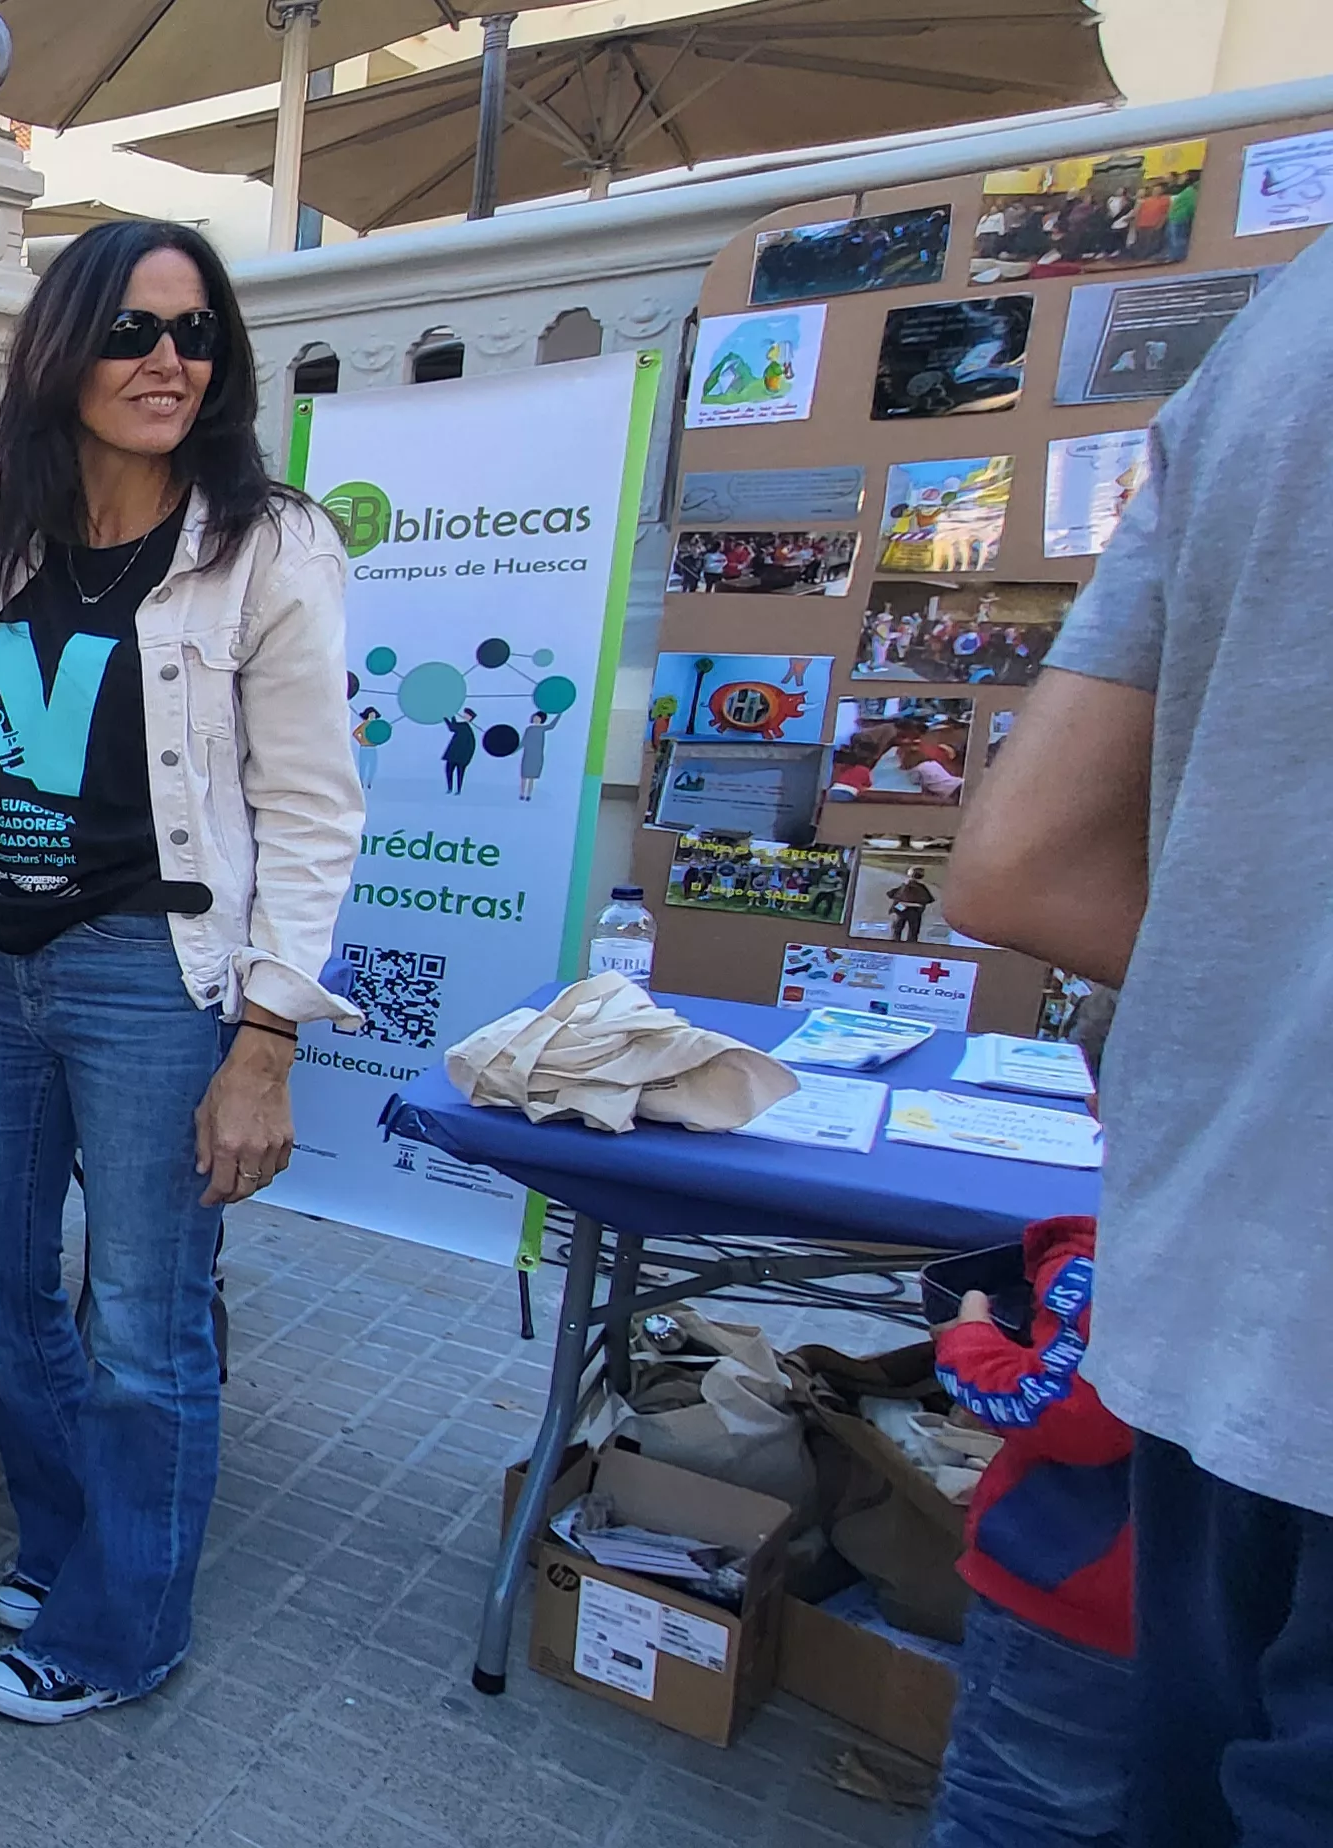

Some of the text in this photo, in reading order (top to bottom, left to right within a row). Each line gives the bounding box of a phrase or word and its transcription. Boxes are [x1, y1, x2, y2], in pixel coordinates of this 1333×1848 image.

[348, 497, 591, 547] Bibliotecas
[353, 558, 588, 582] Campus de Huesca
[44, 854, 75, 867] Night
[353, 883, 525, 922] nosotras!
[898, 985, 966, 1000] Cruz Roja
[549, 1564, 579, 1591] hp
